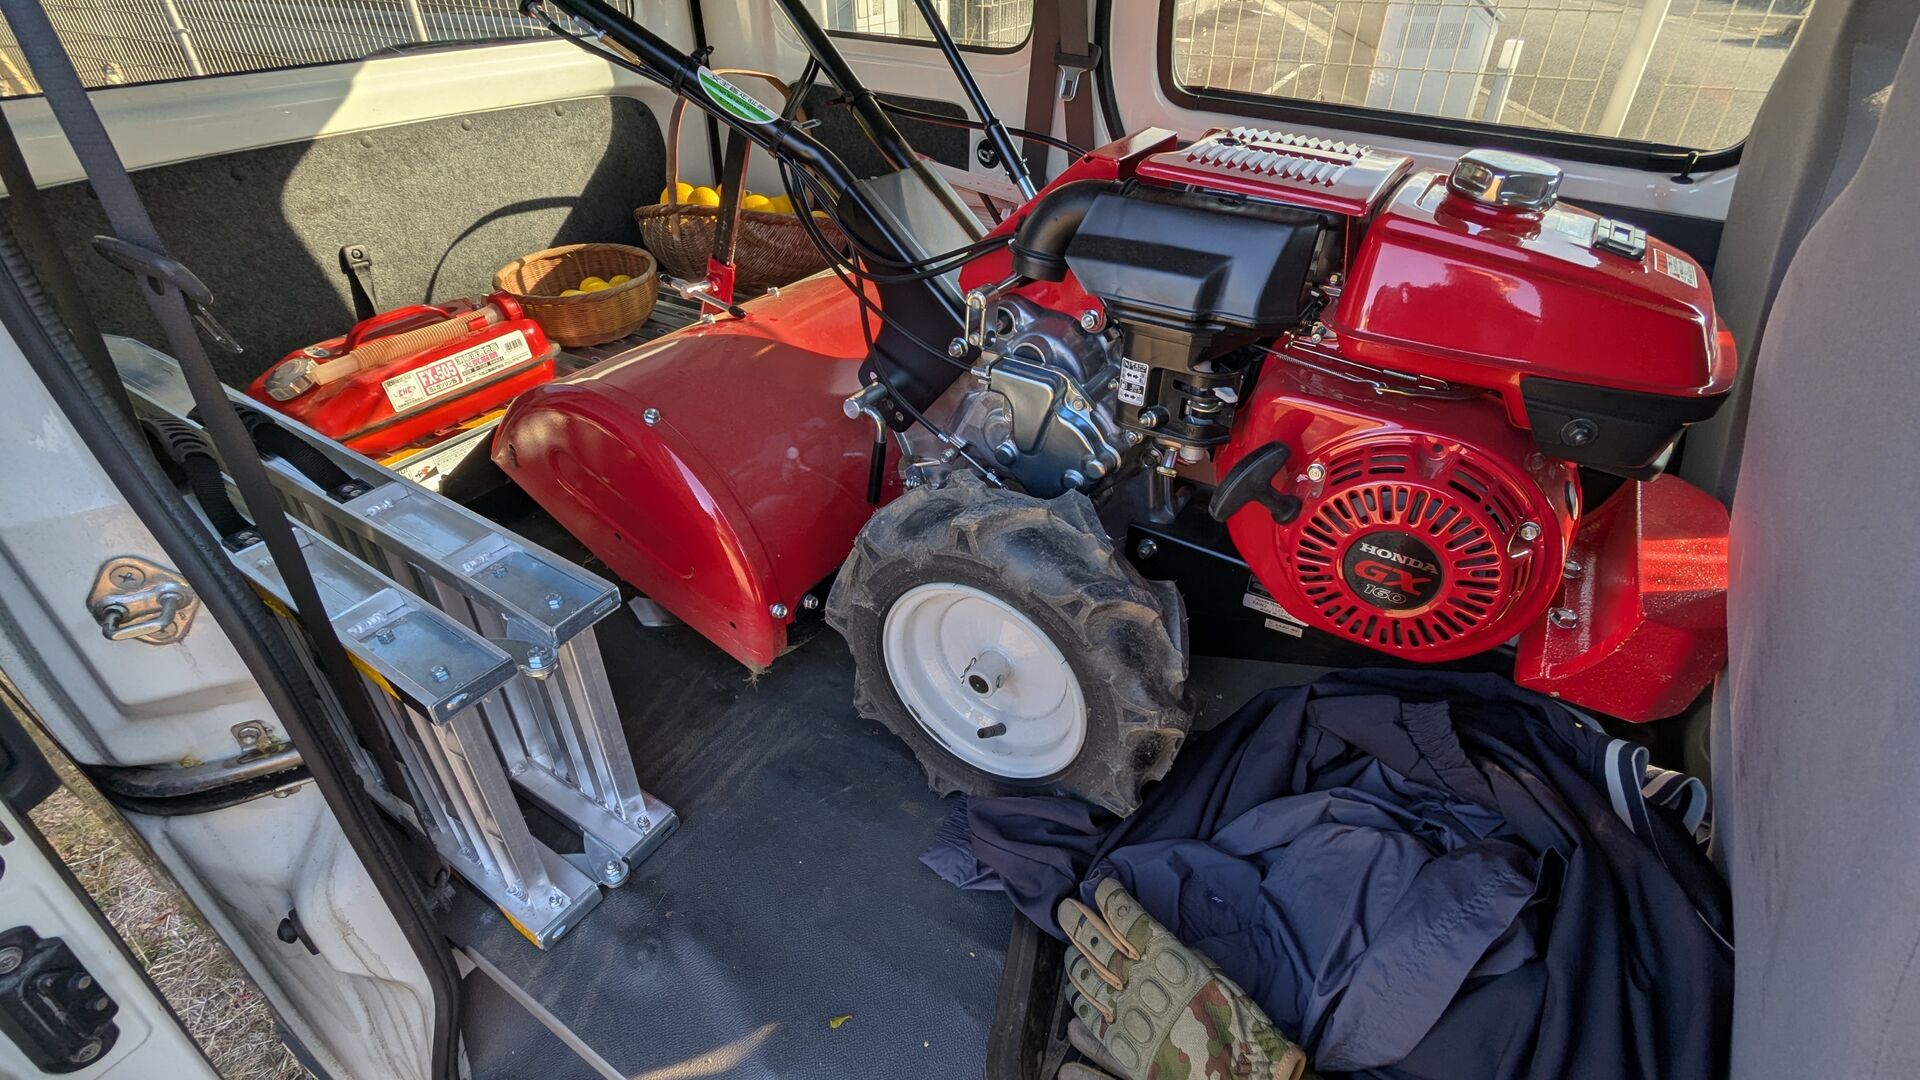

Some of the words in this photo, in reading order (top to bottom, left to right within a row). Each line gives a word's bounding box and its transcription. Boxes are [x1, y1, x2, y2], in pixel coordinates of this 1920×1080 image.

[1359, 542, 1439, 575] HONDA
[1354, 559, 1433, 596] GX
[1363, 583, 1407, 604] 160
